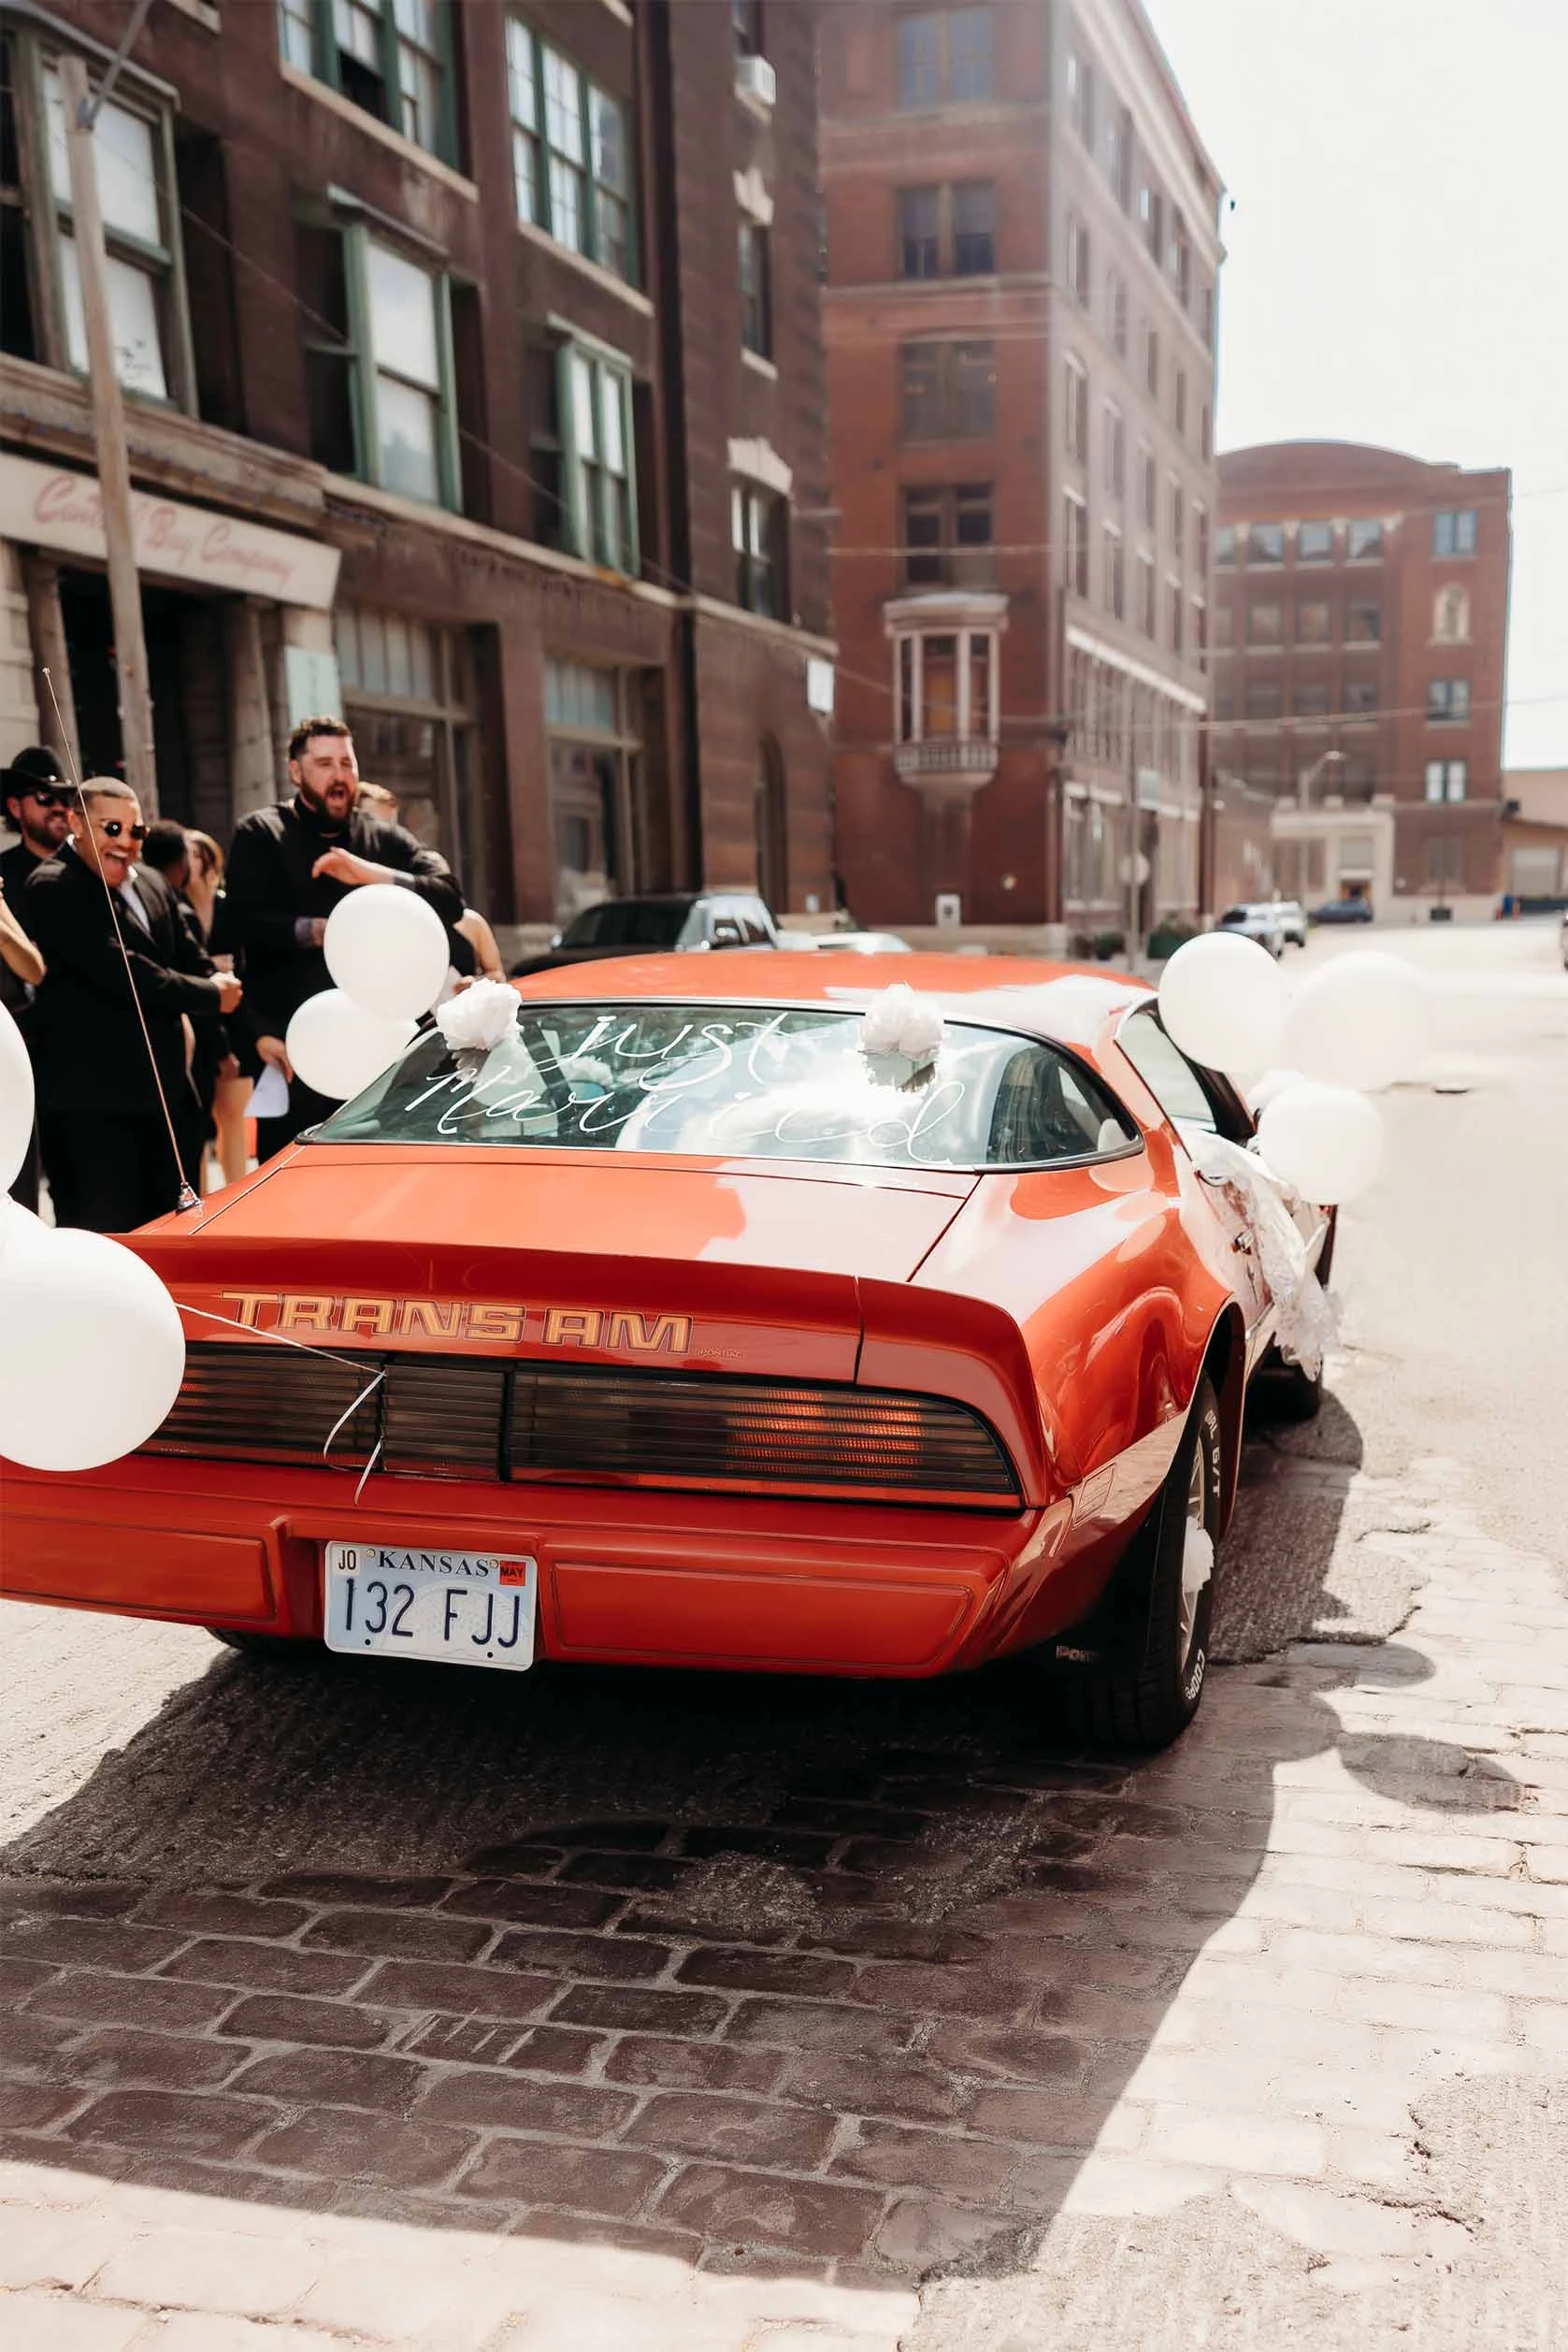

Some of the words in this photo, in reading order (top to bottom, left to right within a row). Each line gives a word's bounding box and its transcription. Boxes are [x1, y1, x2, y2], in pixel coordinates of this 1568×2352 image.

[221, 1290, 525, 1343] TRANS
[540, 1308, 695, 1355] AM
[338, 1549, 357, 1571] JO
[377, 1551, 489, 1578] KANSAS
[500, 1566, 525, 1578] MAY
[345, 1578, 414, 1638] 132
[444, 1588, 521, 1648] FJJ
